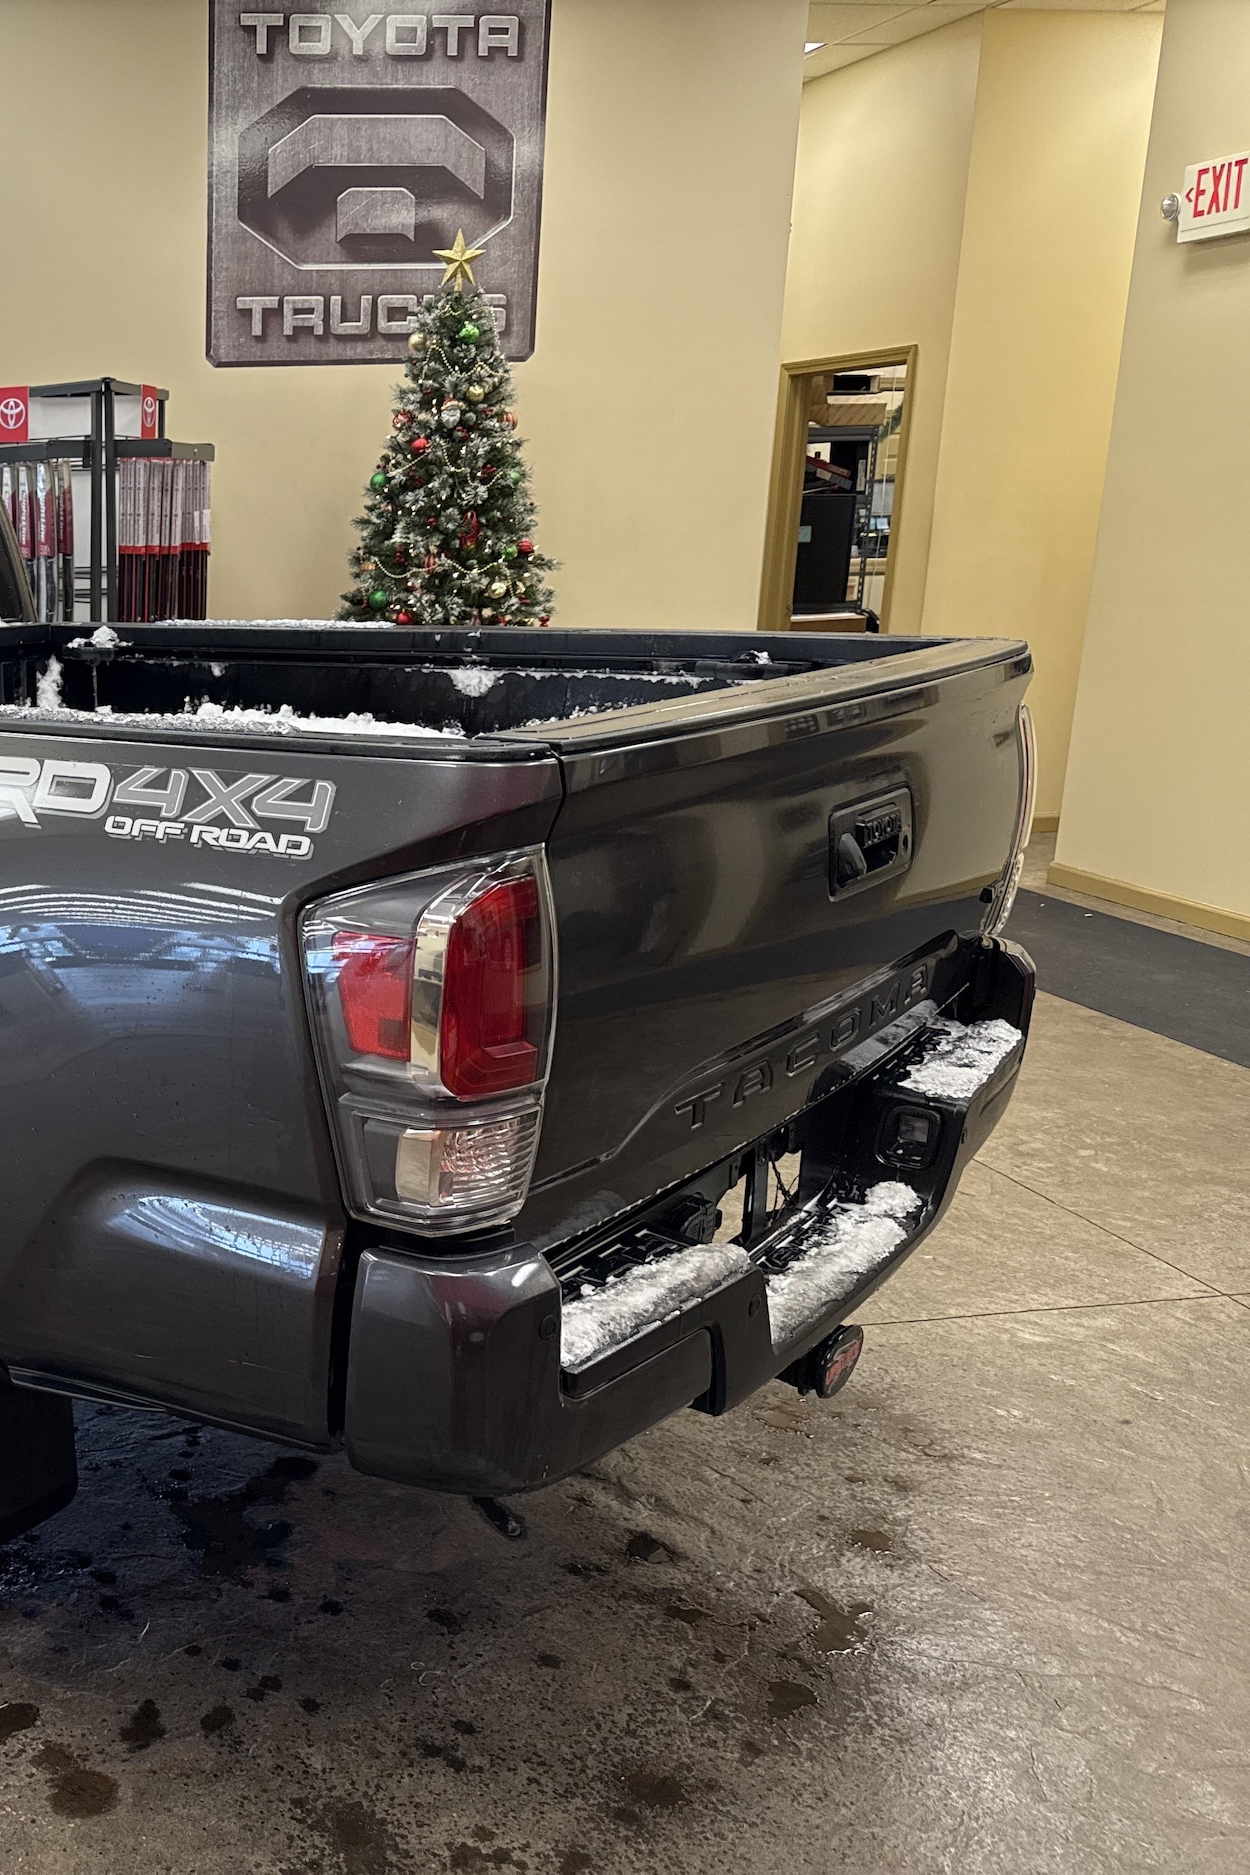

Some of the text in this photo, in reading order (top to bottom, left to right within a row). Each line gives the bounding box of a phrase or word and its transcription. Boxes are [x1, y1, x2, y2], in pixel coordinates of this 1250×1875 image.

[239, 13, 521, 58] TOYOTA
[1192, 157, 1249, 219] EXIT
[236, 294, 508, 337] TRUC
[104, 815, 315, 861] OFF ROAD
[863, 812, 903, 848] TOYOTA
[674, 963, 930, 1130] TACOMA
